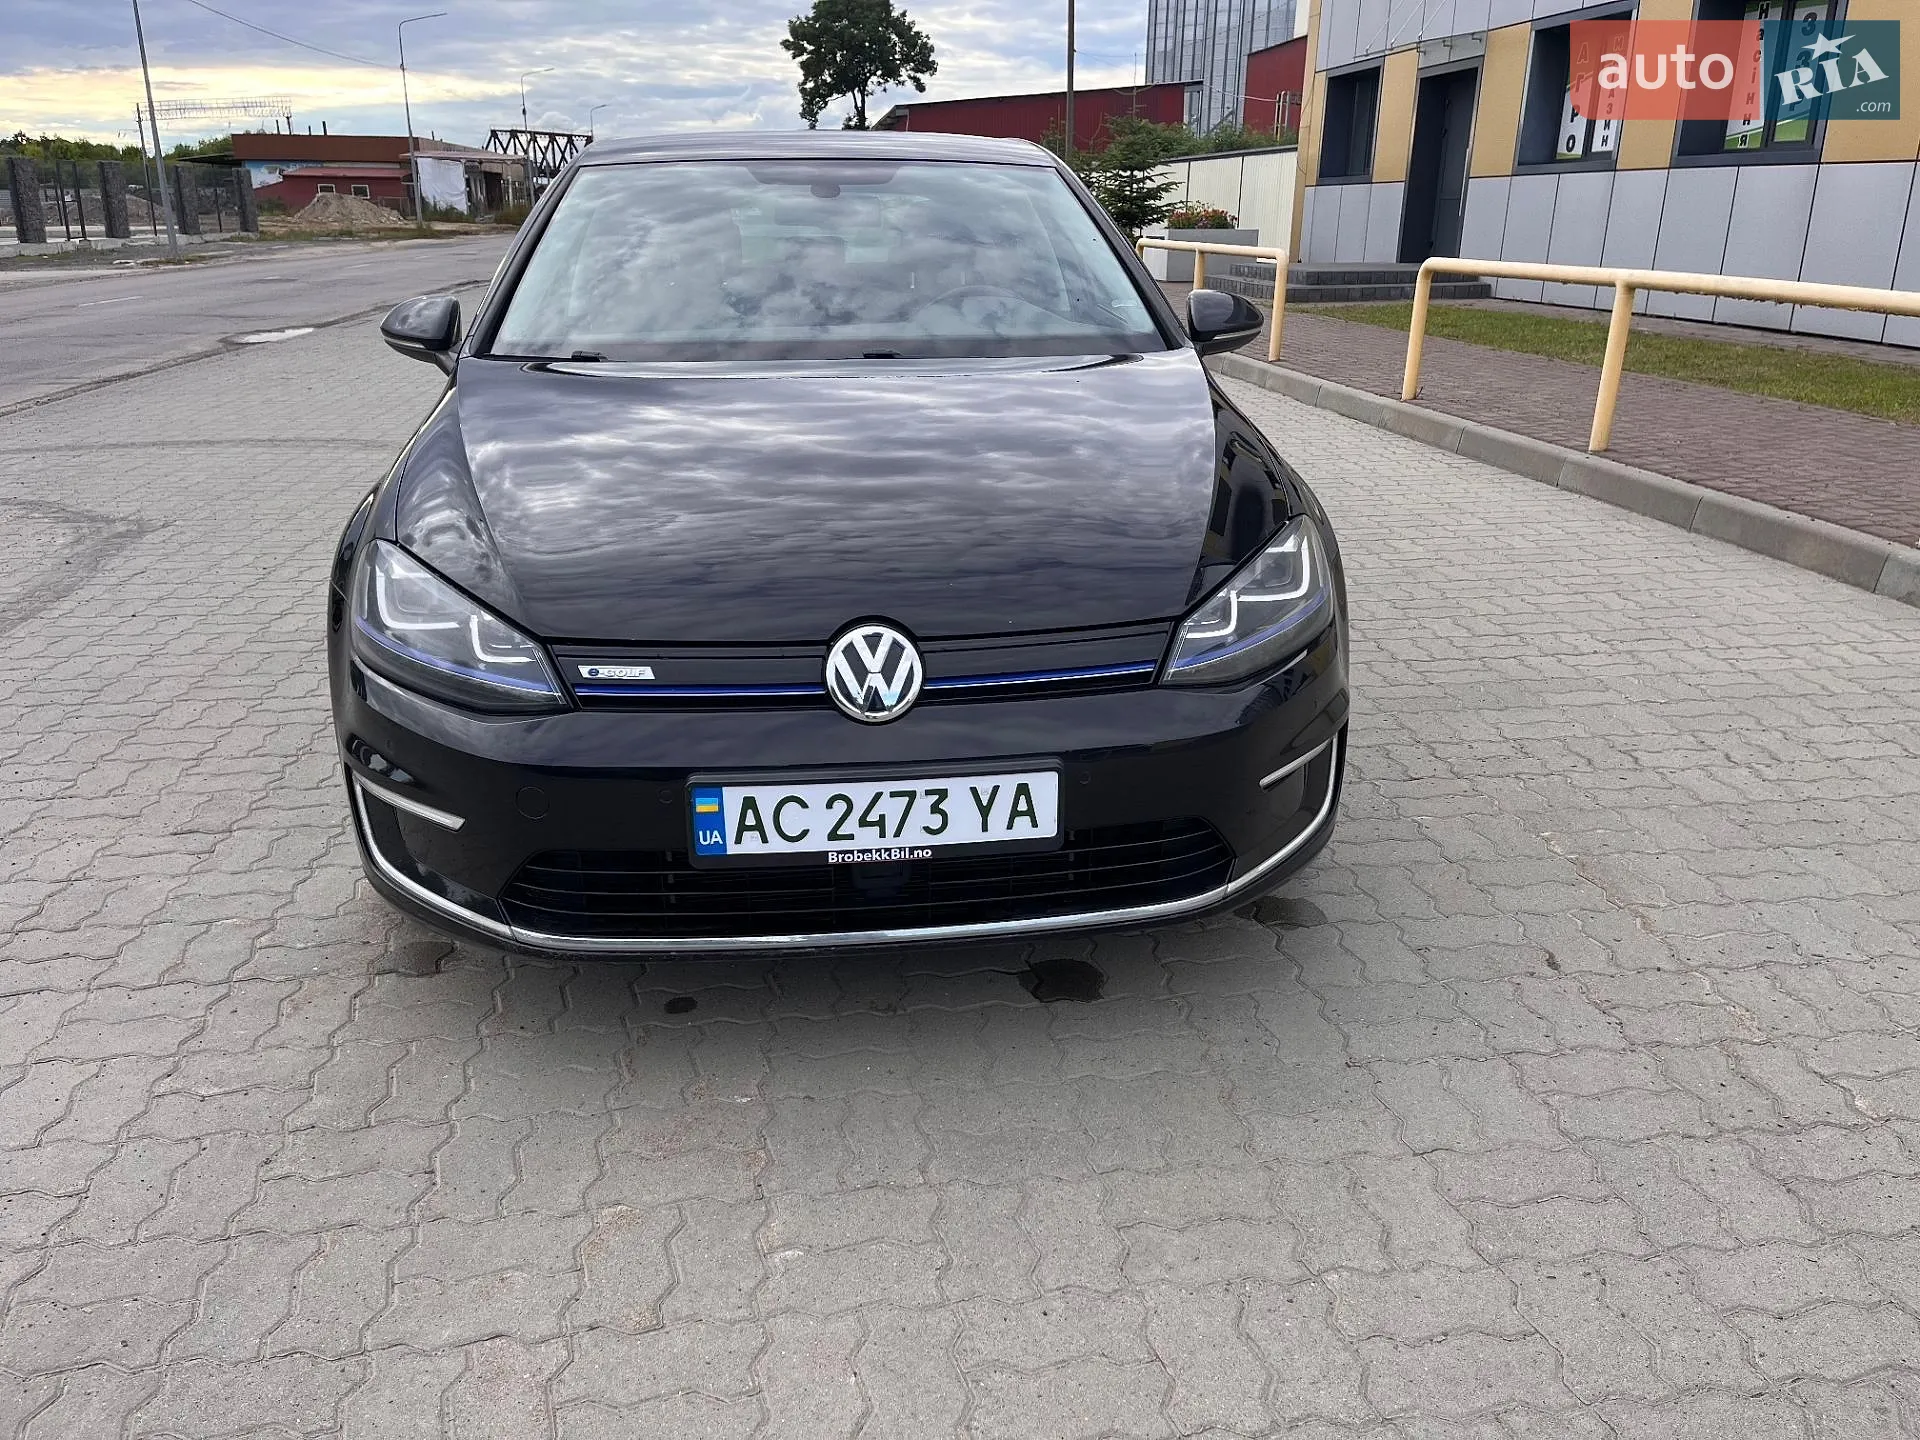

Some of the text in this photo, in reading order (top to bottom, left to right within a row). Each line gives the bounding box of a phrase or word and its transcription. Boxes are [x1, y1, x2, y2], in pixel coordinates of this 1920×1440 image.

[1565, 42, 1589, 153] АГРО
[828, 626, 921, 720] VW
[698, 830, 723, 846] UA
[733, 782, 1039, 845] AC 2473 YA
[827, 847, 933, 863] BrobekkBil.no
